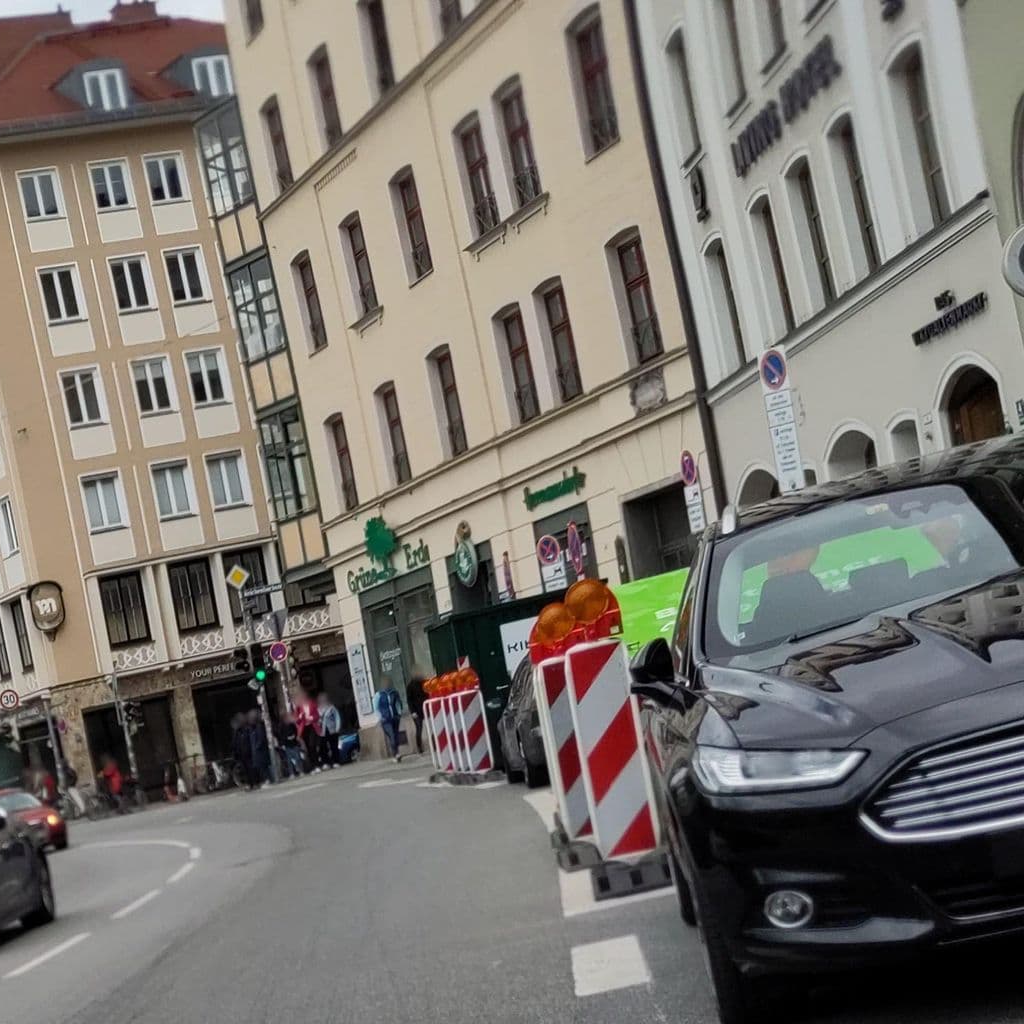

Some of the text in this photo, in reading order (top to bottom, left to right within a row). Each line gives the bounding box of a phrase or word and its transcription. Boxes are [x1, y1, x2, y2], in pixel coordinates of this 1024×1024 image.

[347, 567, 377, 594] Grüne
[402, 538, 430, 569] Erde
[3, 694, 15, 704] 30
